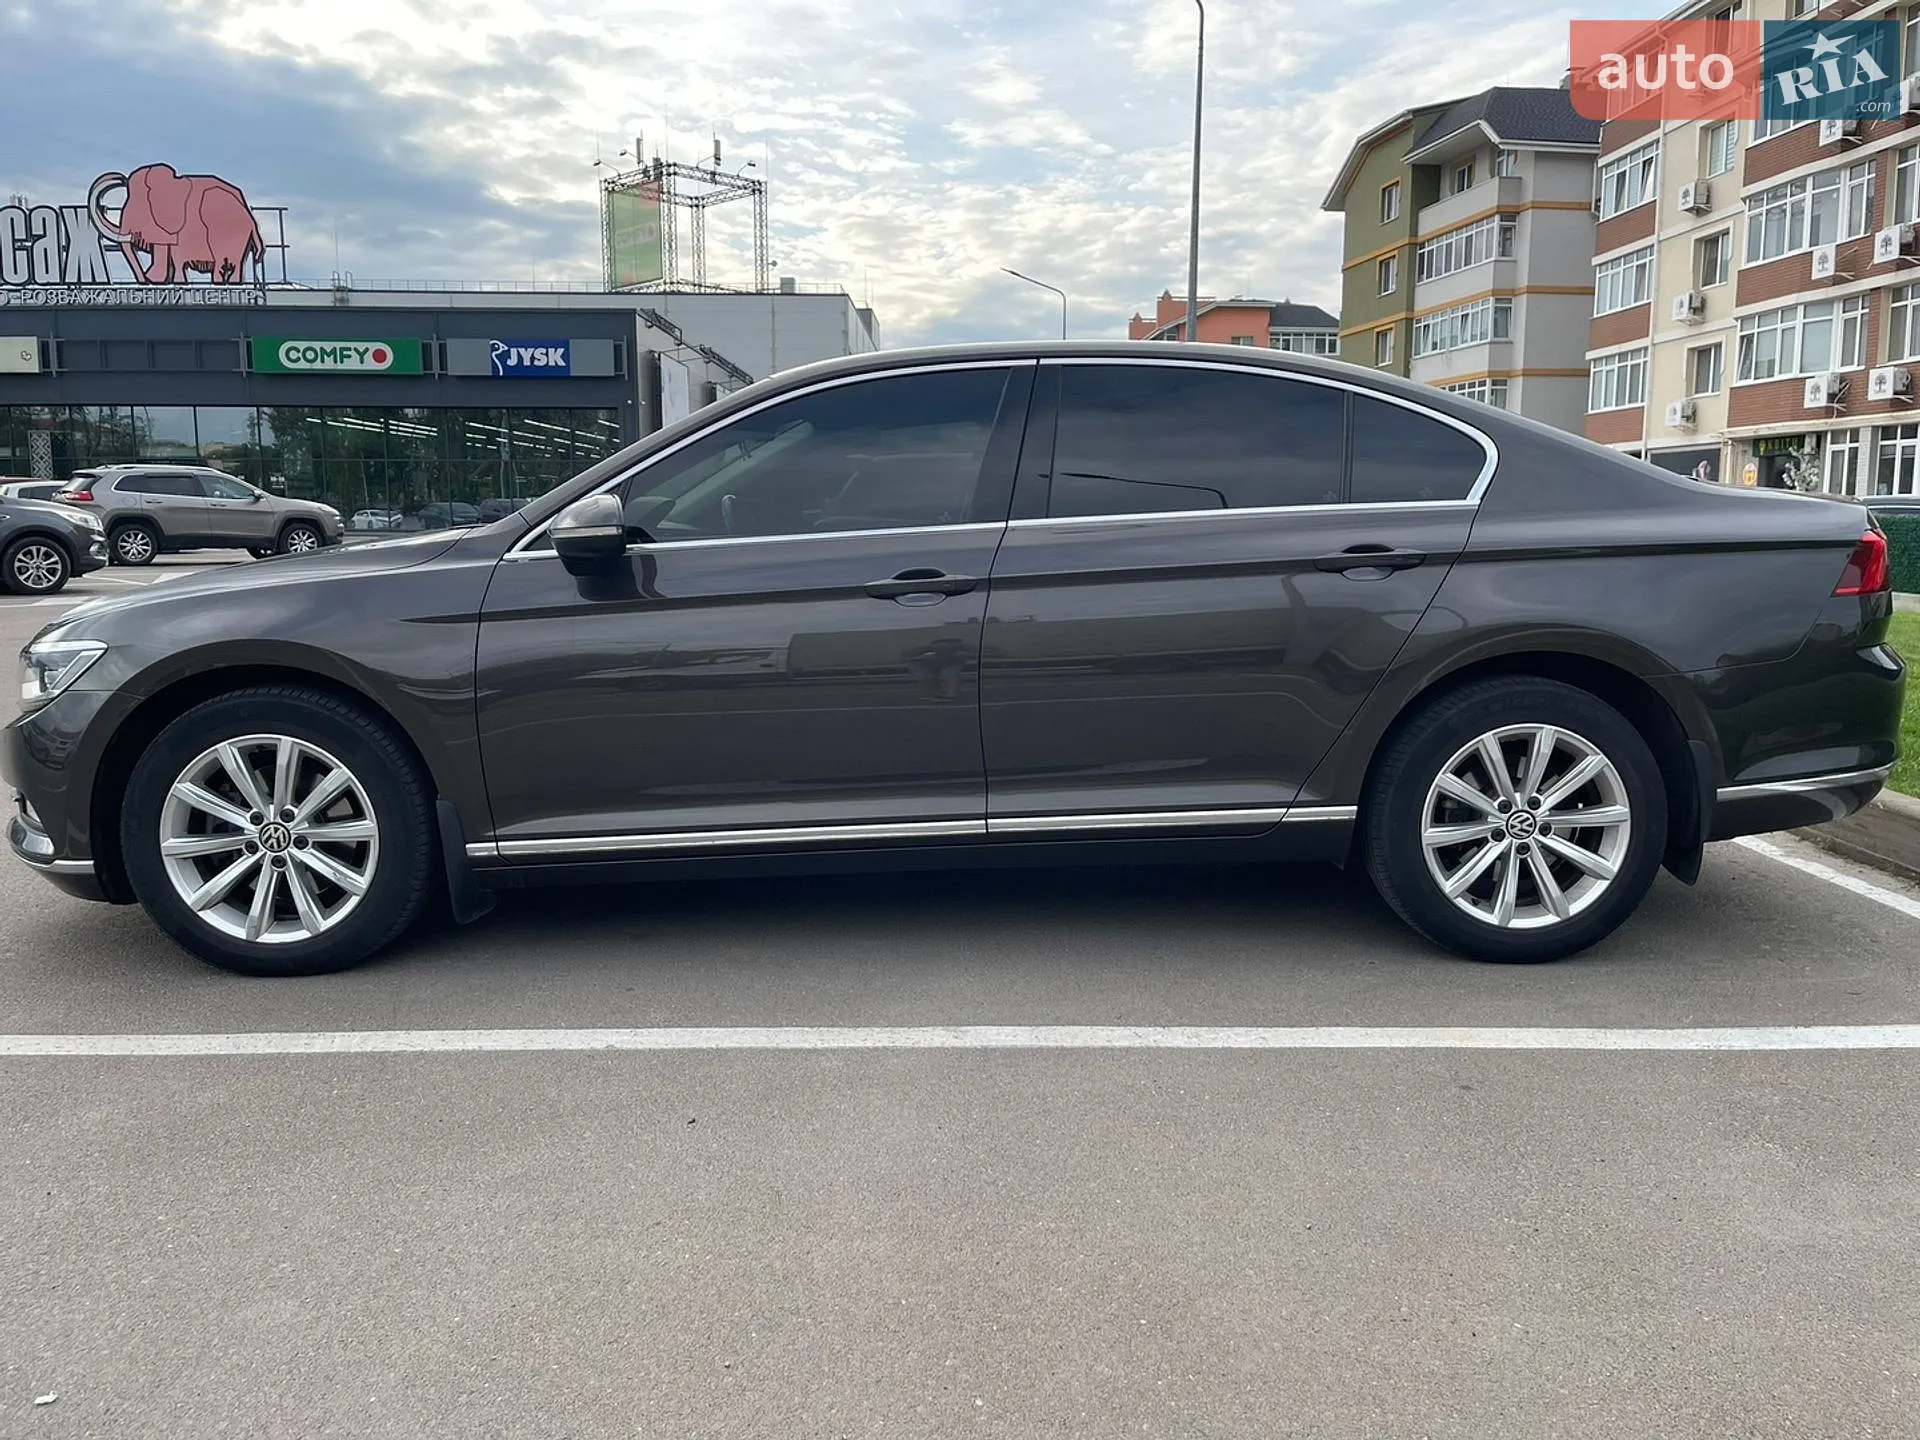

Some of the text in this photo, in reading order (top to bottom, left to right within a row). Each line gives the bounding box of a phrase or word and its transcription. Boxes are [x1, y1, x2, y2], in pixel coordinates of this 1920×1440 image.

[191, 288, 256, 305] ЦЕНТР
[284, 346, 369, 364] COMFY
[506, 347, 567, 366] JYSK
